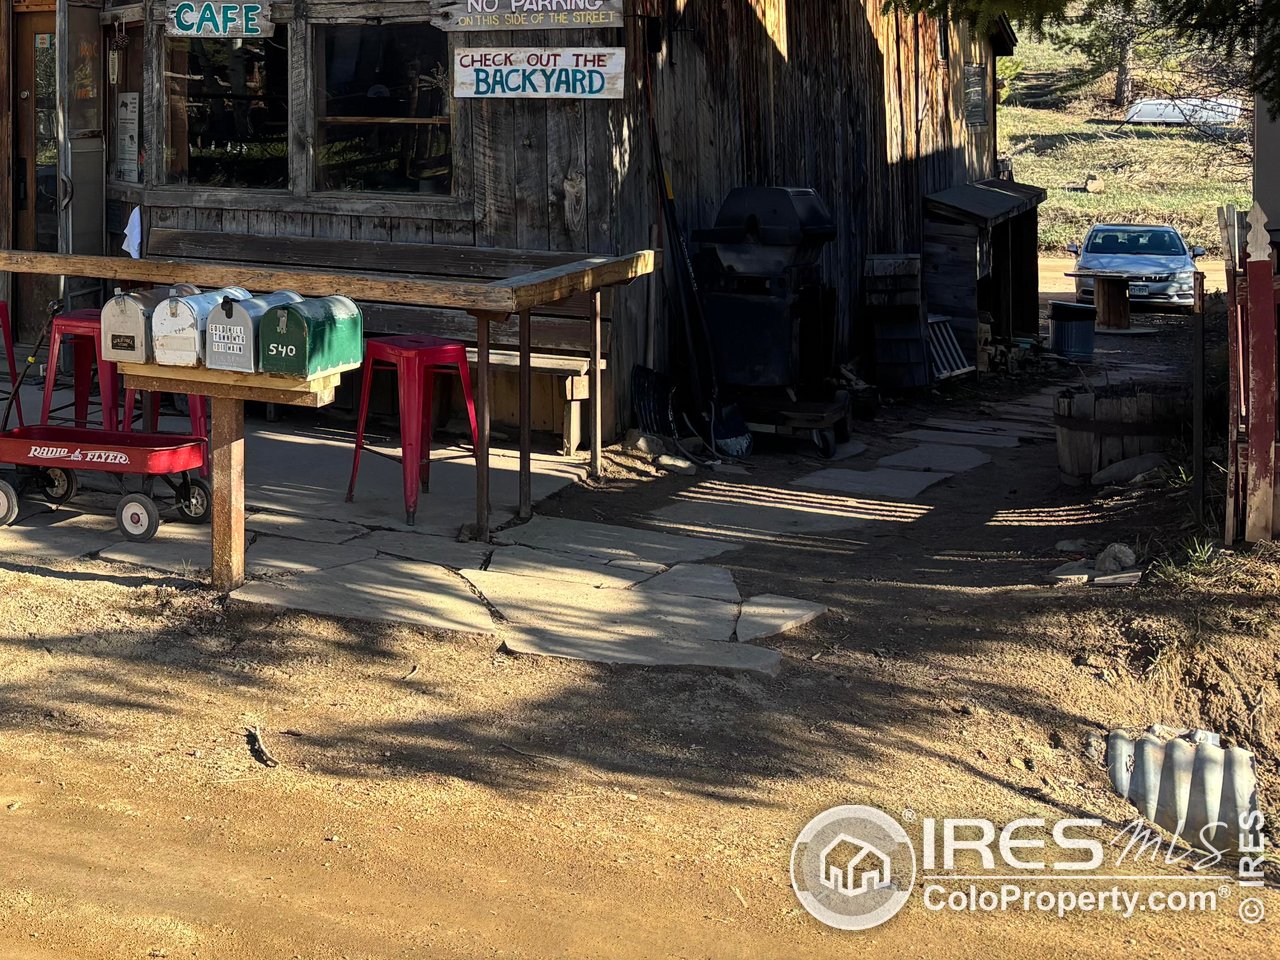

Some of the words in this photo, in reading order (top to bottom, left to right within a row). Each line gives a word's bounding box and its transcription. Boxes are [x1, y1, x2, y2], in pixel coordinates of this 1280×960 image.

[174, 2, 261, 35] CAFE
[458, 16, 473, 26] ON
[475, 15, 499, 26] THIS
[505, 13, 529, 25] SIDE
[531, 13, 545, 24] OF
[550, 12, 569, 24] THE
[572, 11, 616, 23] STREET
[460, 53, 514, 68] CHECK
[527, 53, 561, 68] OUT
[572, 53, 607, 68] THE
[473, 68, 605, 96] BACKYARD
[28, 446, 69, 458] RADIO
[85, 451, 130, 464] FLYER
